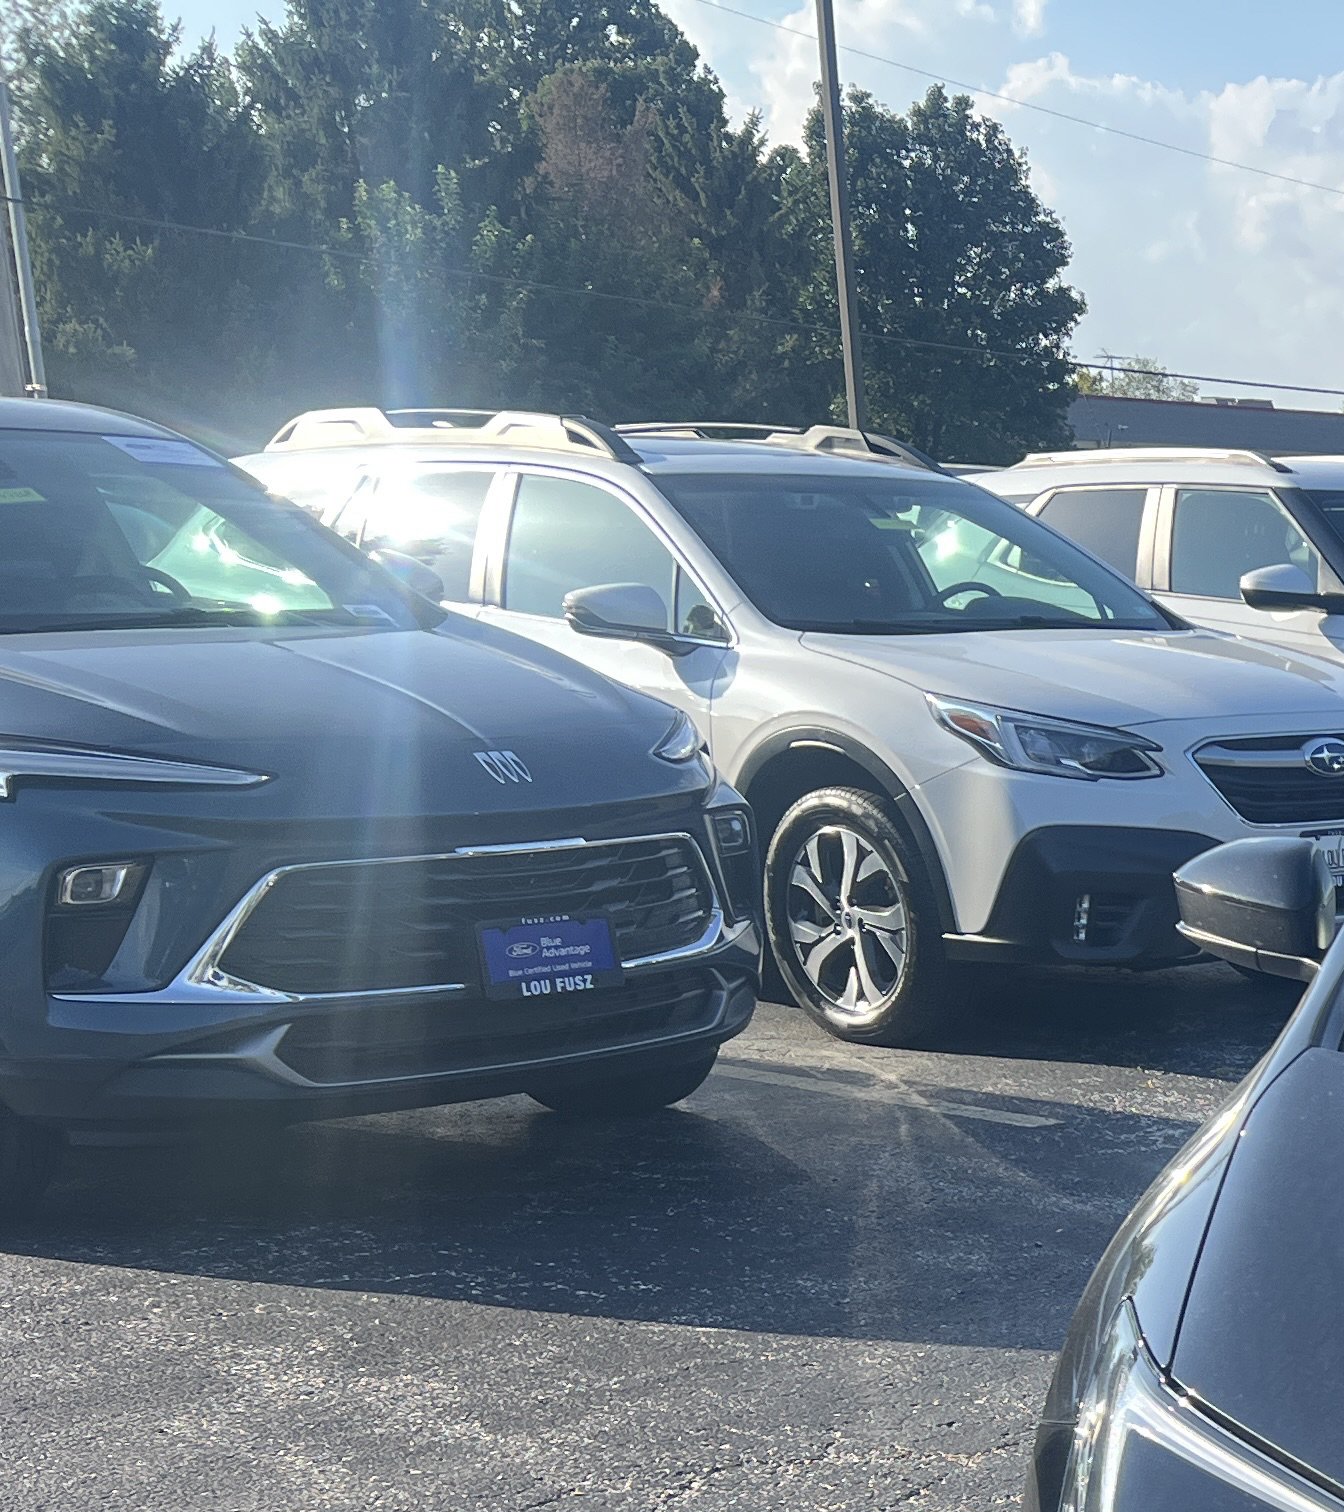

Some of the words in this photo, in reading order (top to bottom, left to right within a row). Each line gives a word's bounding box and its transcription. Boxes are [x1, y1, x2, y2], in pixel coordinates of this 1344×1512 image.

[540, 937, 562, 948] Blue
[541, 945, 591, 958] Advantage
[521, 979, 551, 997] LOU
[555, 974, 594, 993] FUSZ
